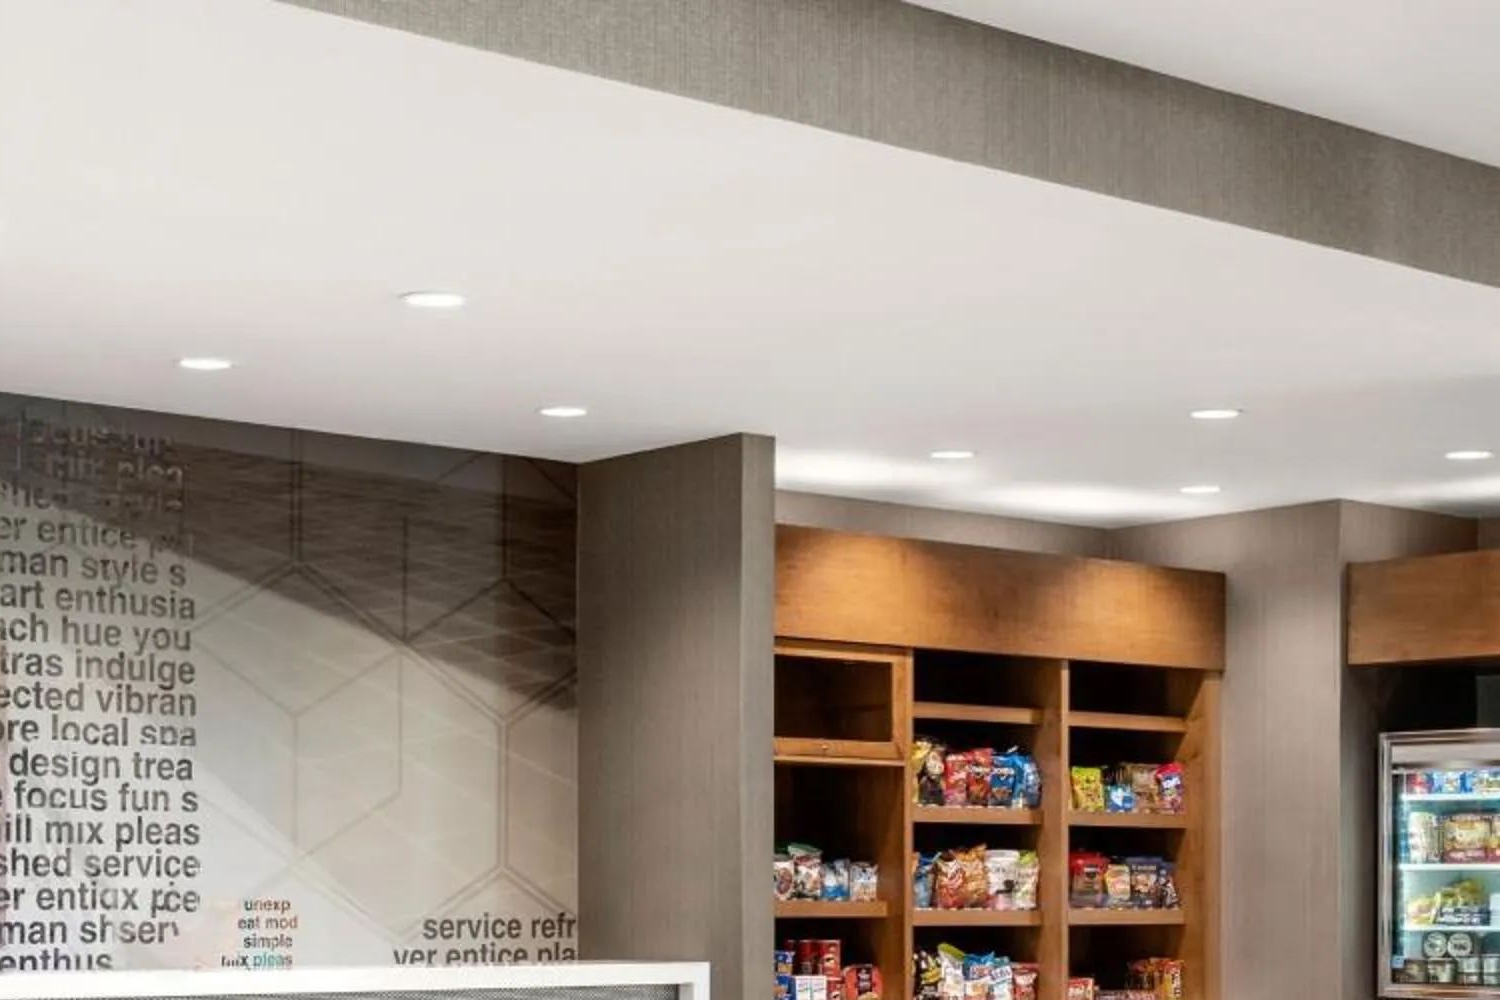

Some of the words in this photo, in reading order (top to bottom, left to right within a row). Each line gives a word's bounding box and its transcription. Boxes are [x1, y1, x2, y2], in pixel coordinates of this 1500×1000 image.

[36, 517, 136, 549] entice
[80, 553, 159, 588] style
[169, 564, 186, 587] s
[0, 581, 45, 609] art
[55, 587, 195, 620] enthusia
[61, 616, 122, 647] hue
[133, 626, 192, 656] you
[0, 647, 64, 677] tras
[74, 648, 196, 690] indulge
[95, 683, 197, 717] vibran
[51, 714, 129, 747] local
[9, 748, 121, 787] design
[132, 751, 193, 781] trea
[13, 779, 108, 812] focus
[117, 782, 170, 813] fun
[181, 789, 199, 813] s
[45, 819, 104, 845] mix
[115, 815, 201, 853] pleas
[83, 848, 201, 879] service
[422, 911, 523, 941] service
[530, 911, 577, 939] refr
